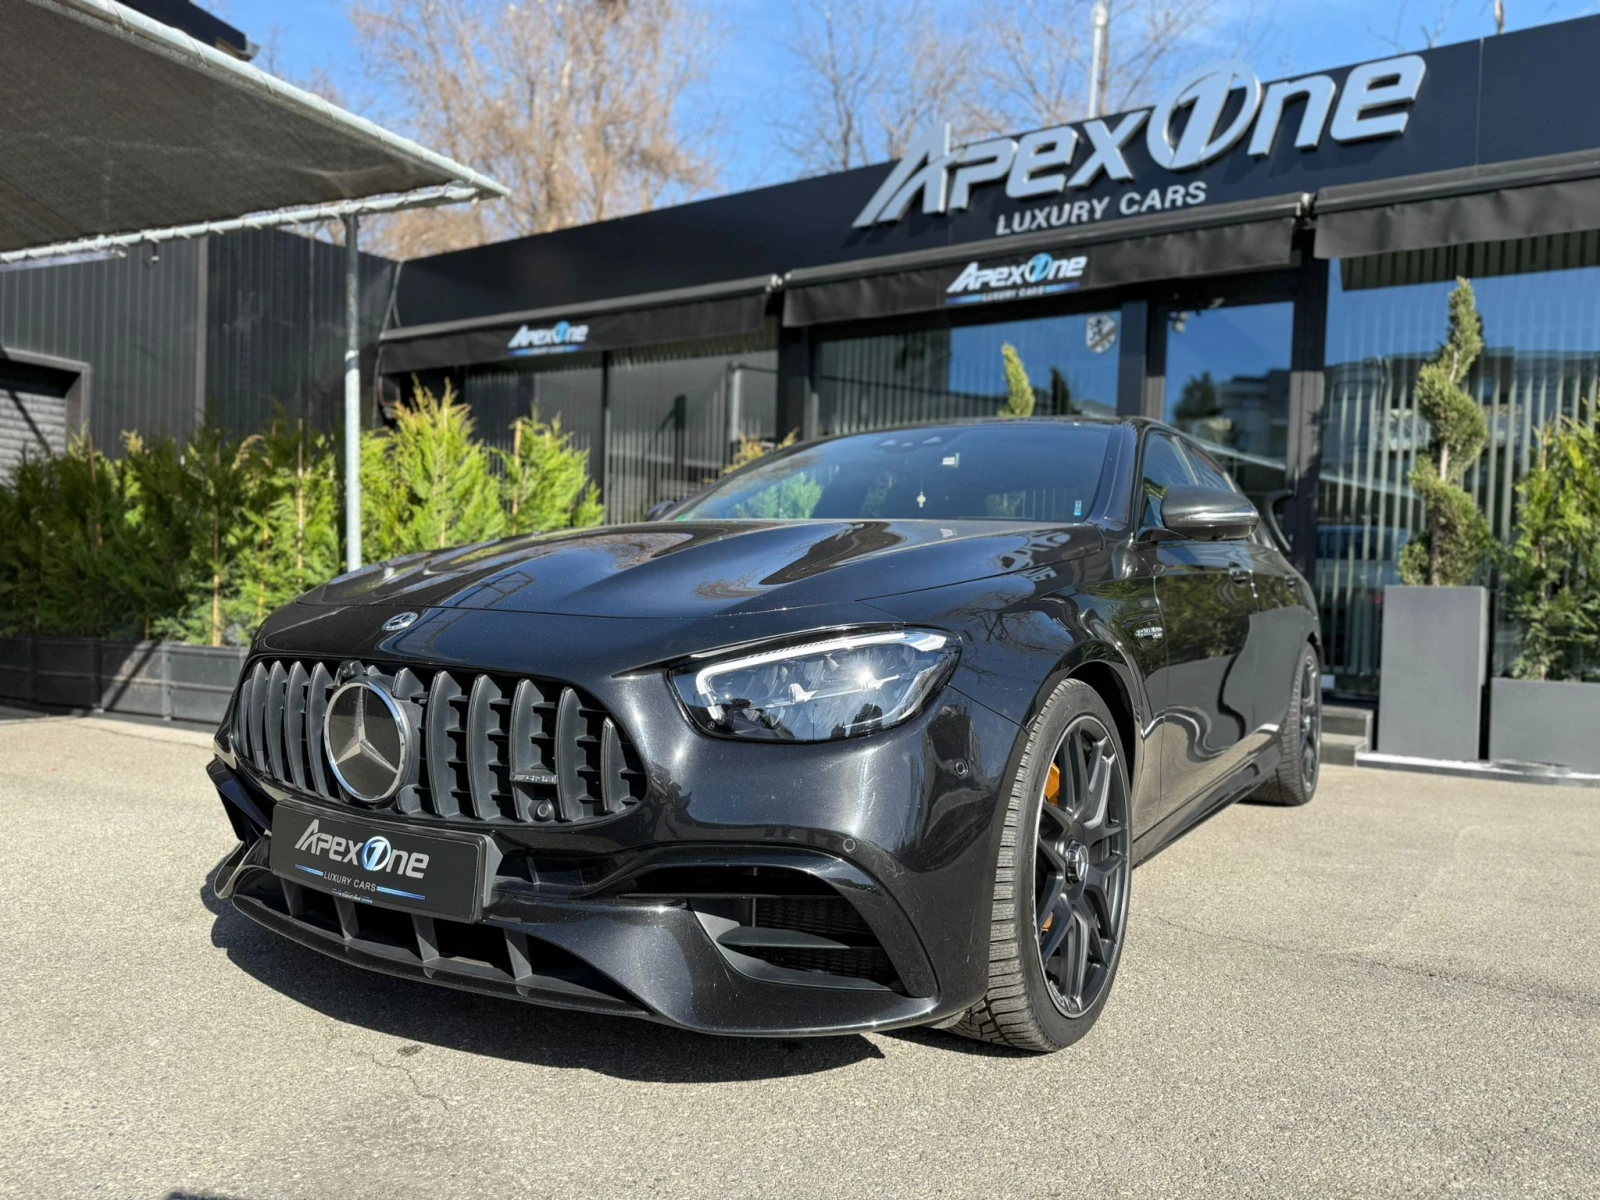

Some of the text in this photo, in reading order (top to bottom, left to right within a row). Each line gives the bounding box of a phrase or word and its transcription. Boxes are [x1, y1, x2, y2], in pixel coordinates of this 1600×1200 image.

[995, 181, 1208, 236] LUXURY CARS
[323, 871, 377, 892] LUXURY CARS
